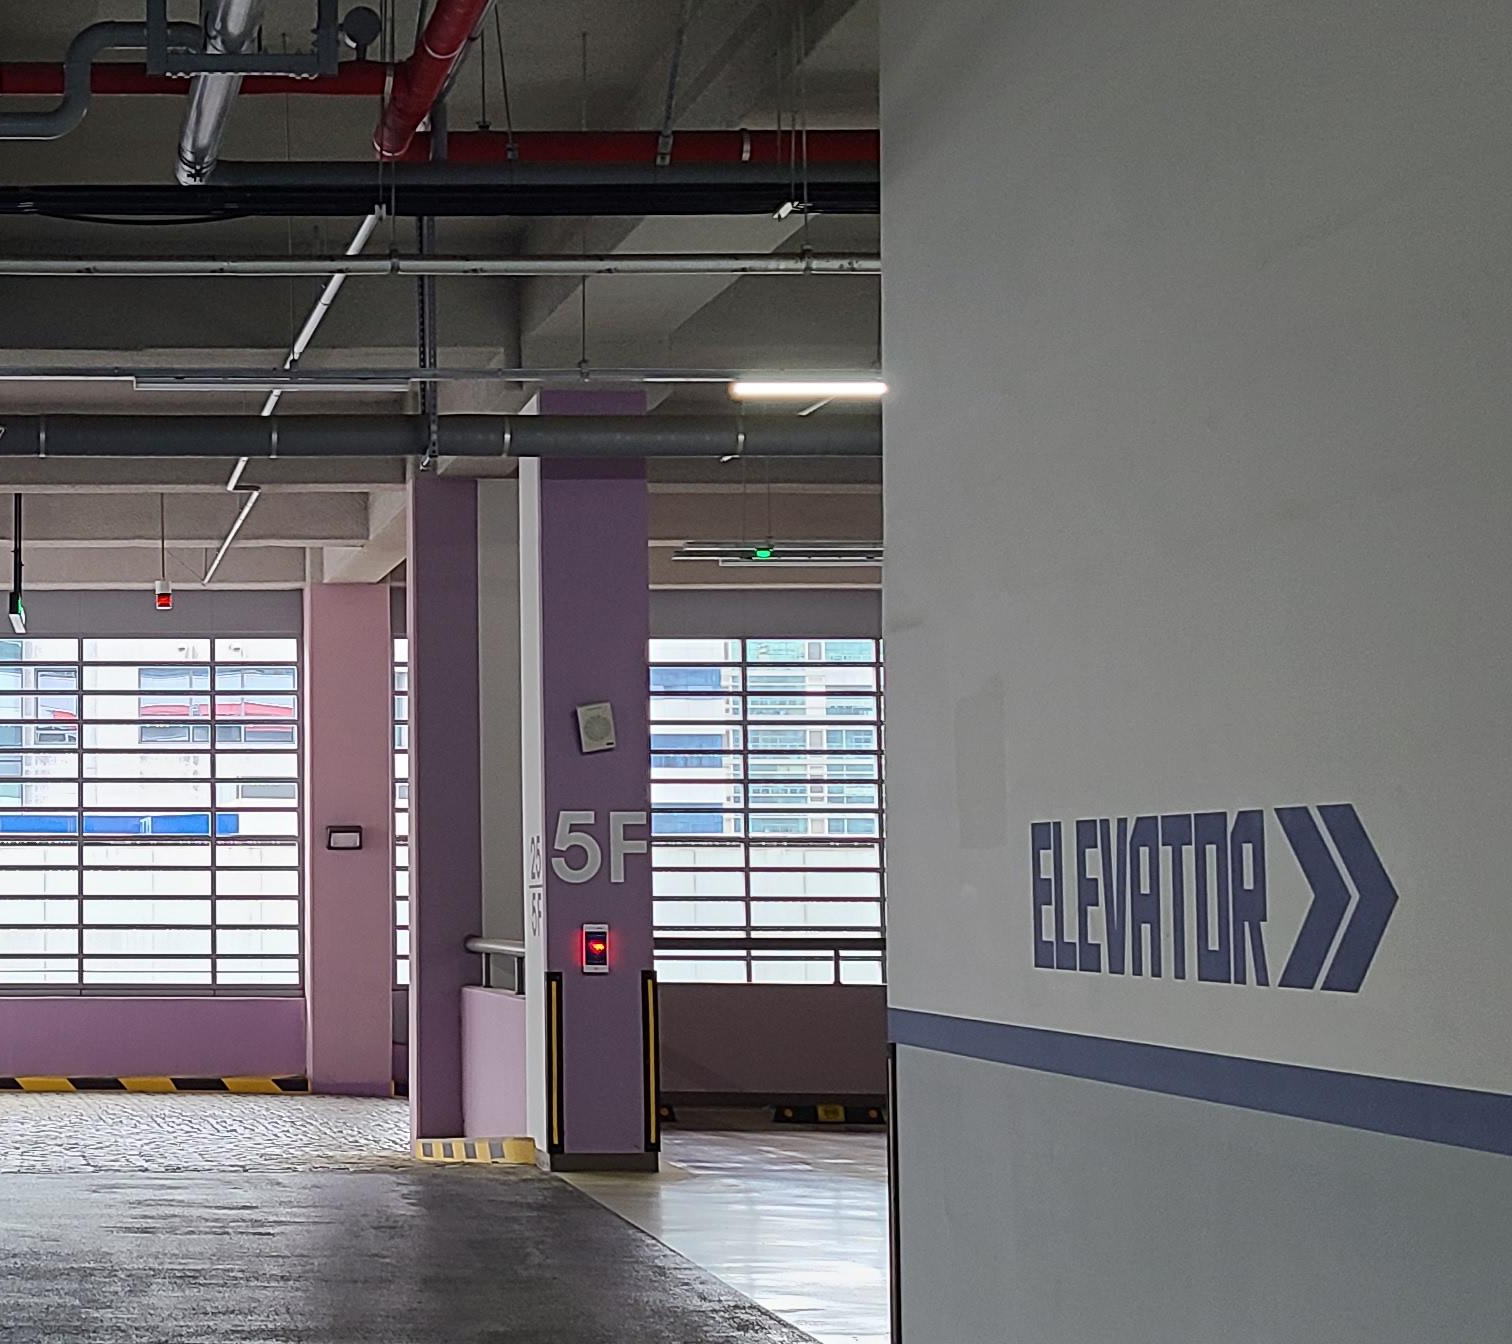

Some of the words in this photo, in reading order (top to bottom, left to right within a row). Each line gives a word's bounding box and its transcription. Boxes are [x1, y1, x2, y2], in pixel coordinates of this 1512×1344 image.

[530, 836, 542, 883] 25
[551, 810, 648, 884] 5F
[531, 892, 542, 937] 5F
[1031, 808, 1270, 988] ELEVATOR
